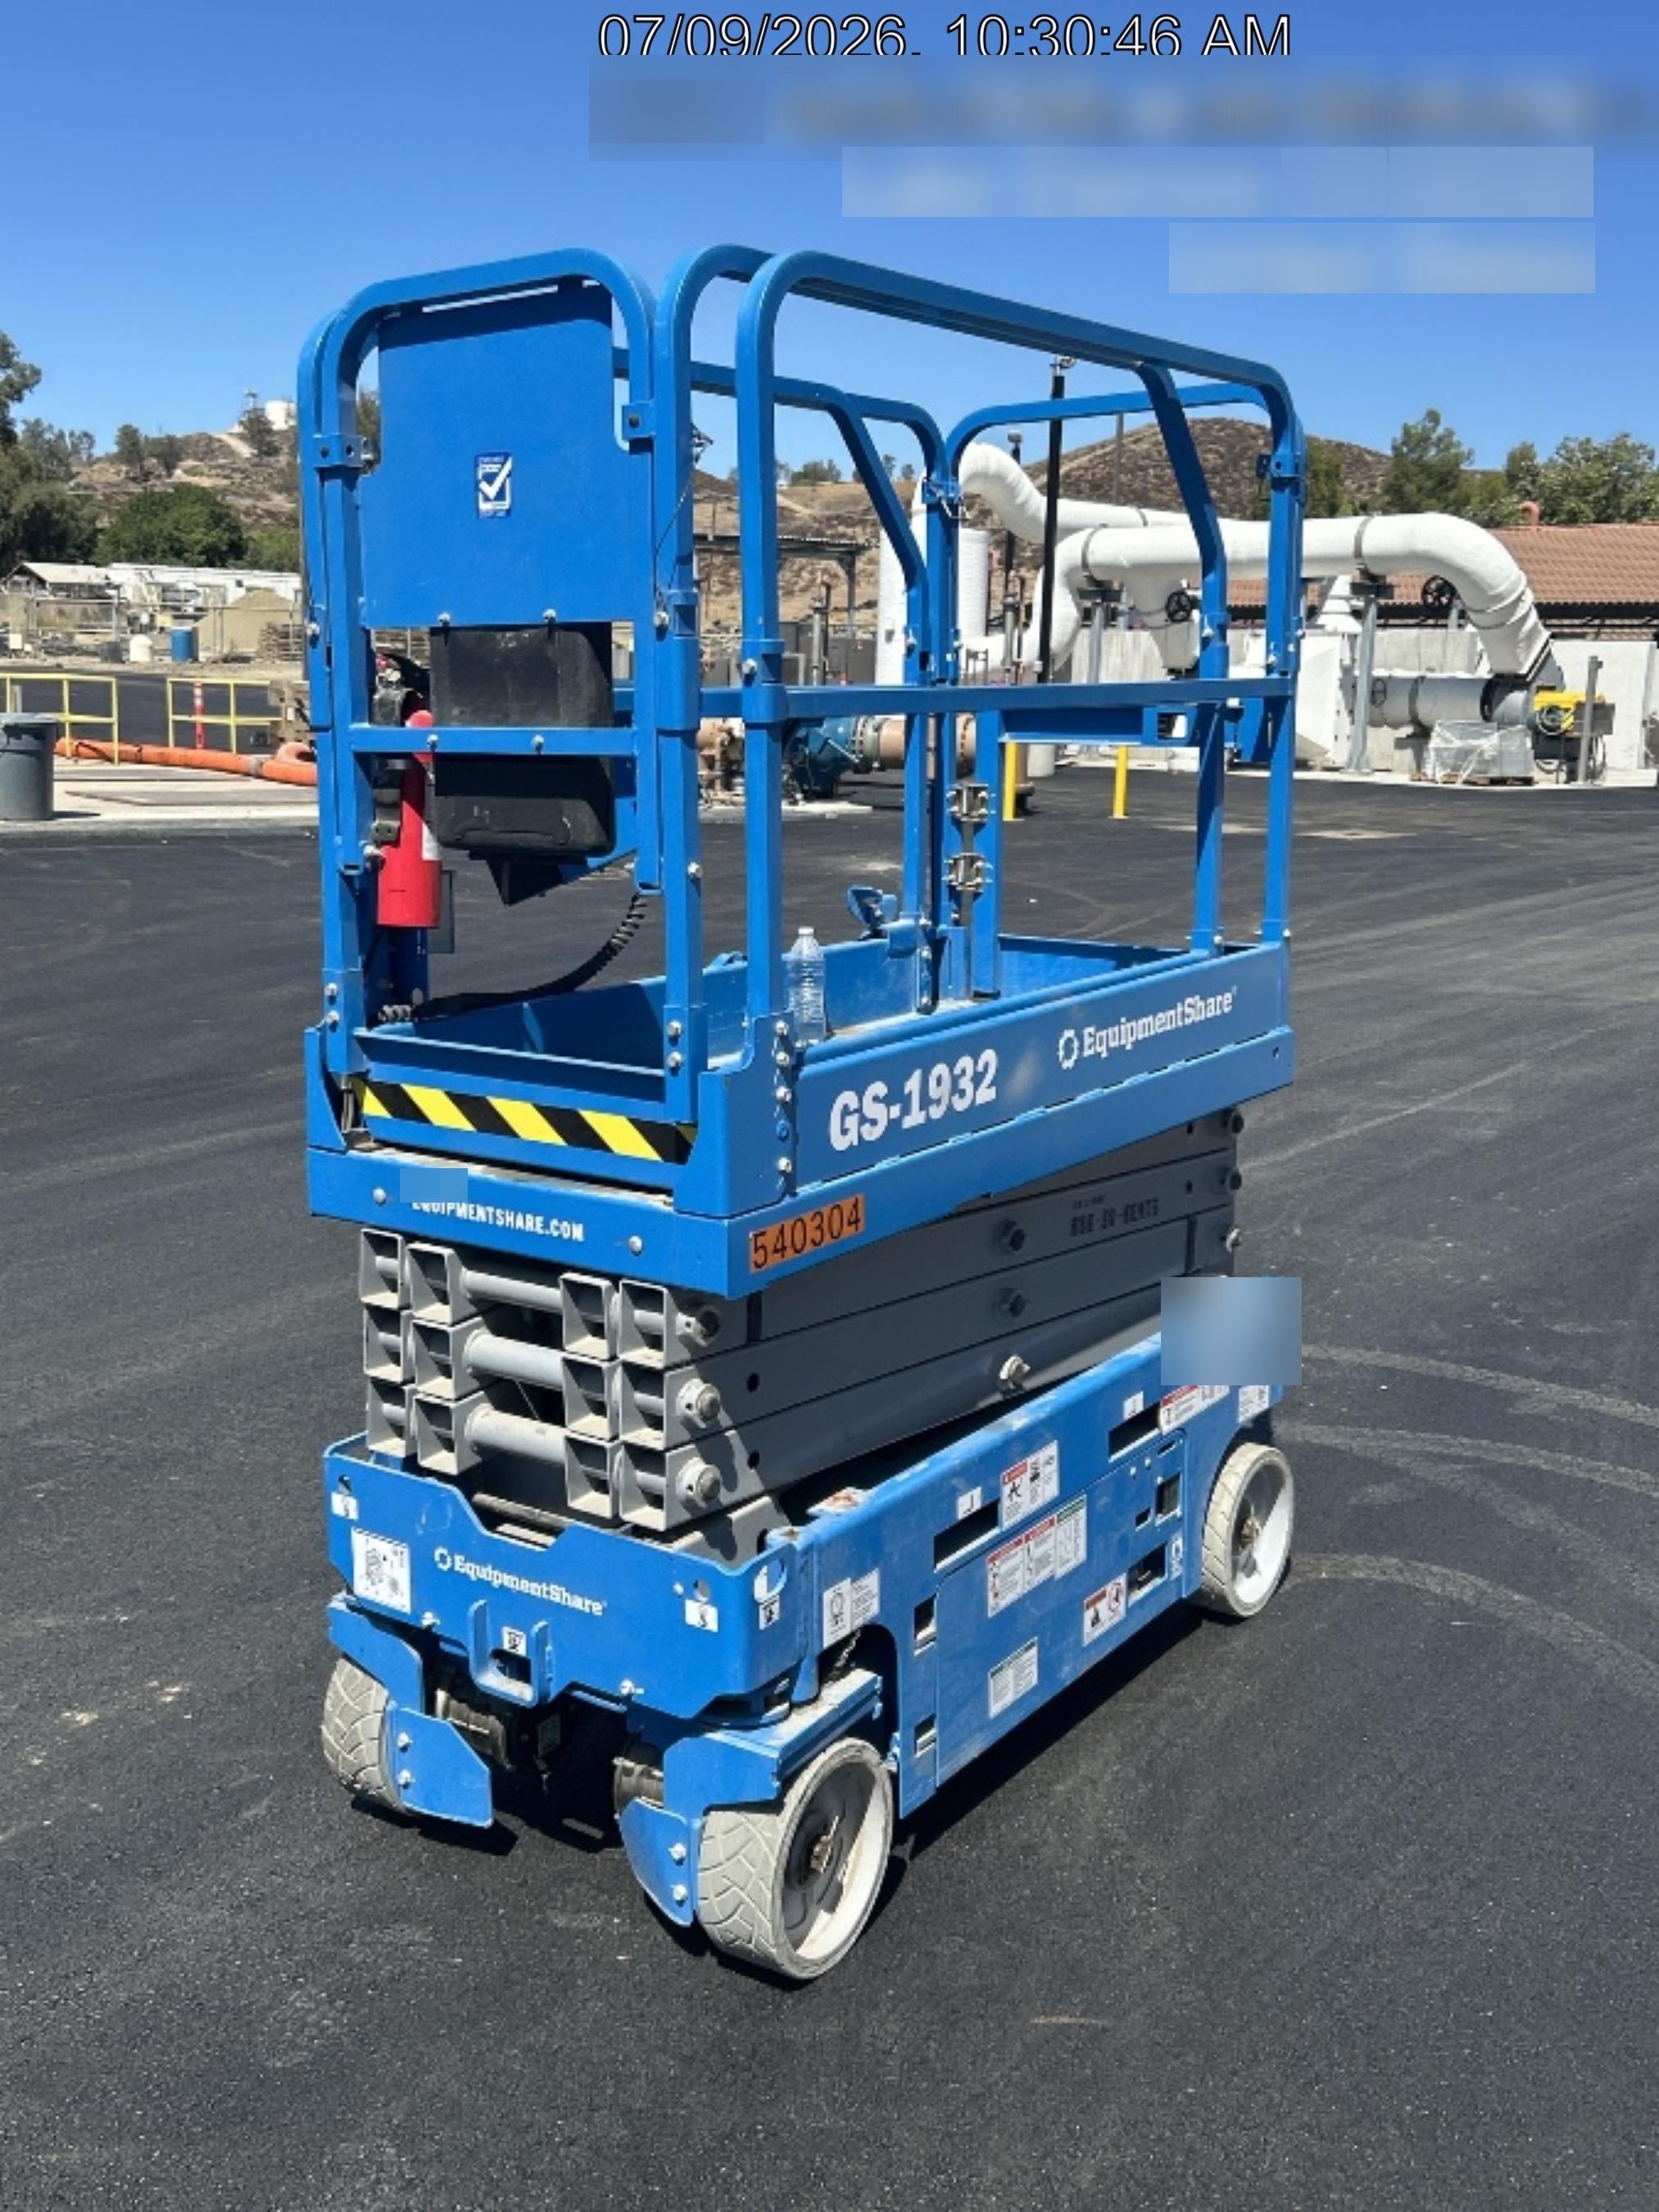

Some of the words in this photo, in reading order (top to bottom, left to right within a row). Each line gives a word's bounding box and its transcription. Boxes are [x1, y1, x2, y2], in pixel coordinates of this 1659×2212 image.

[1082, 991, 1233, 1058] EquipmentShare
[829, 1048, 999, 1151] GS-1932
[752, 1195, 861, 1269] 540304
